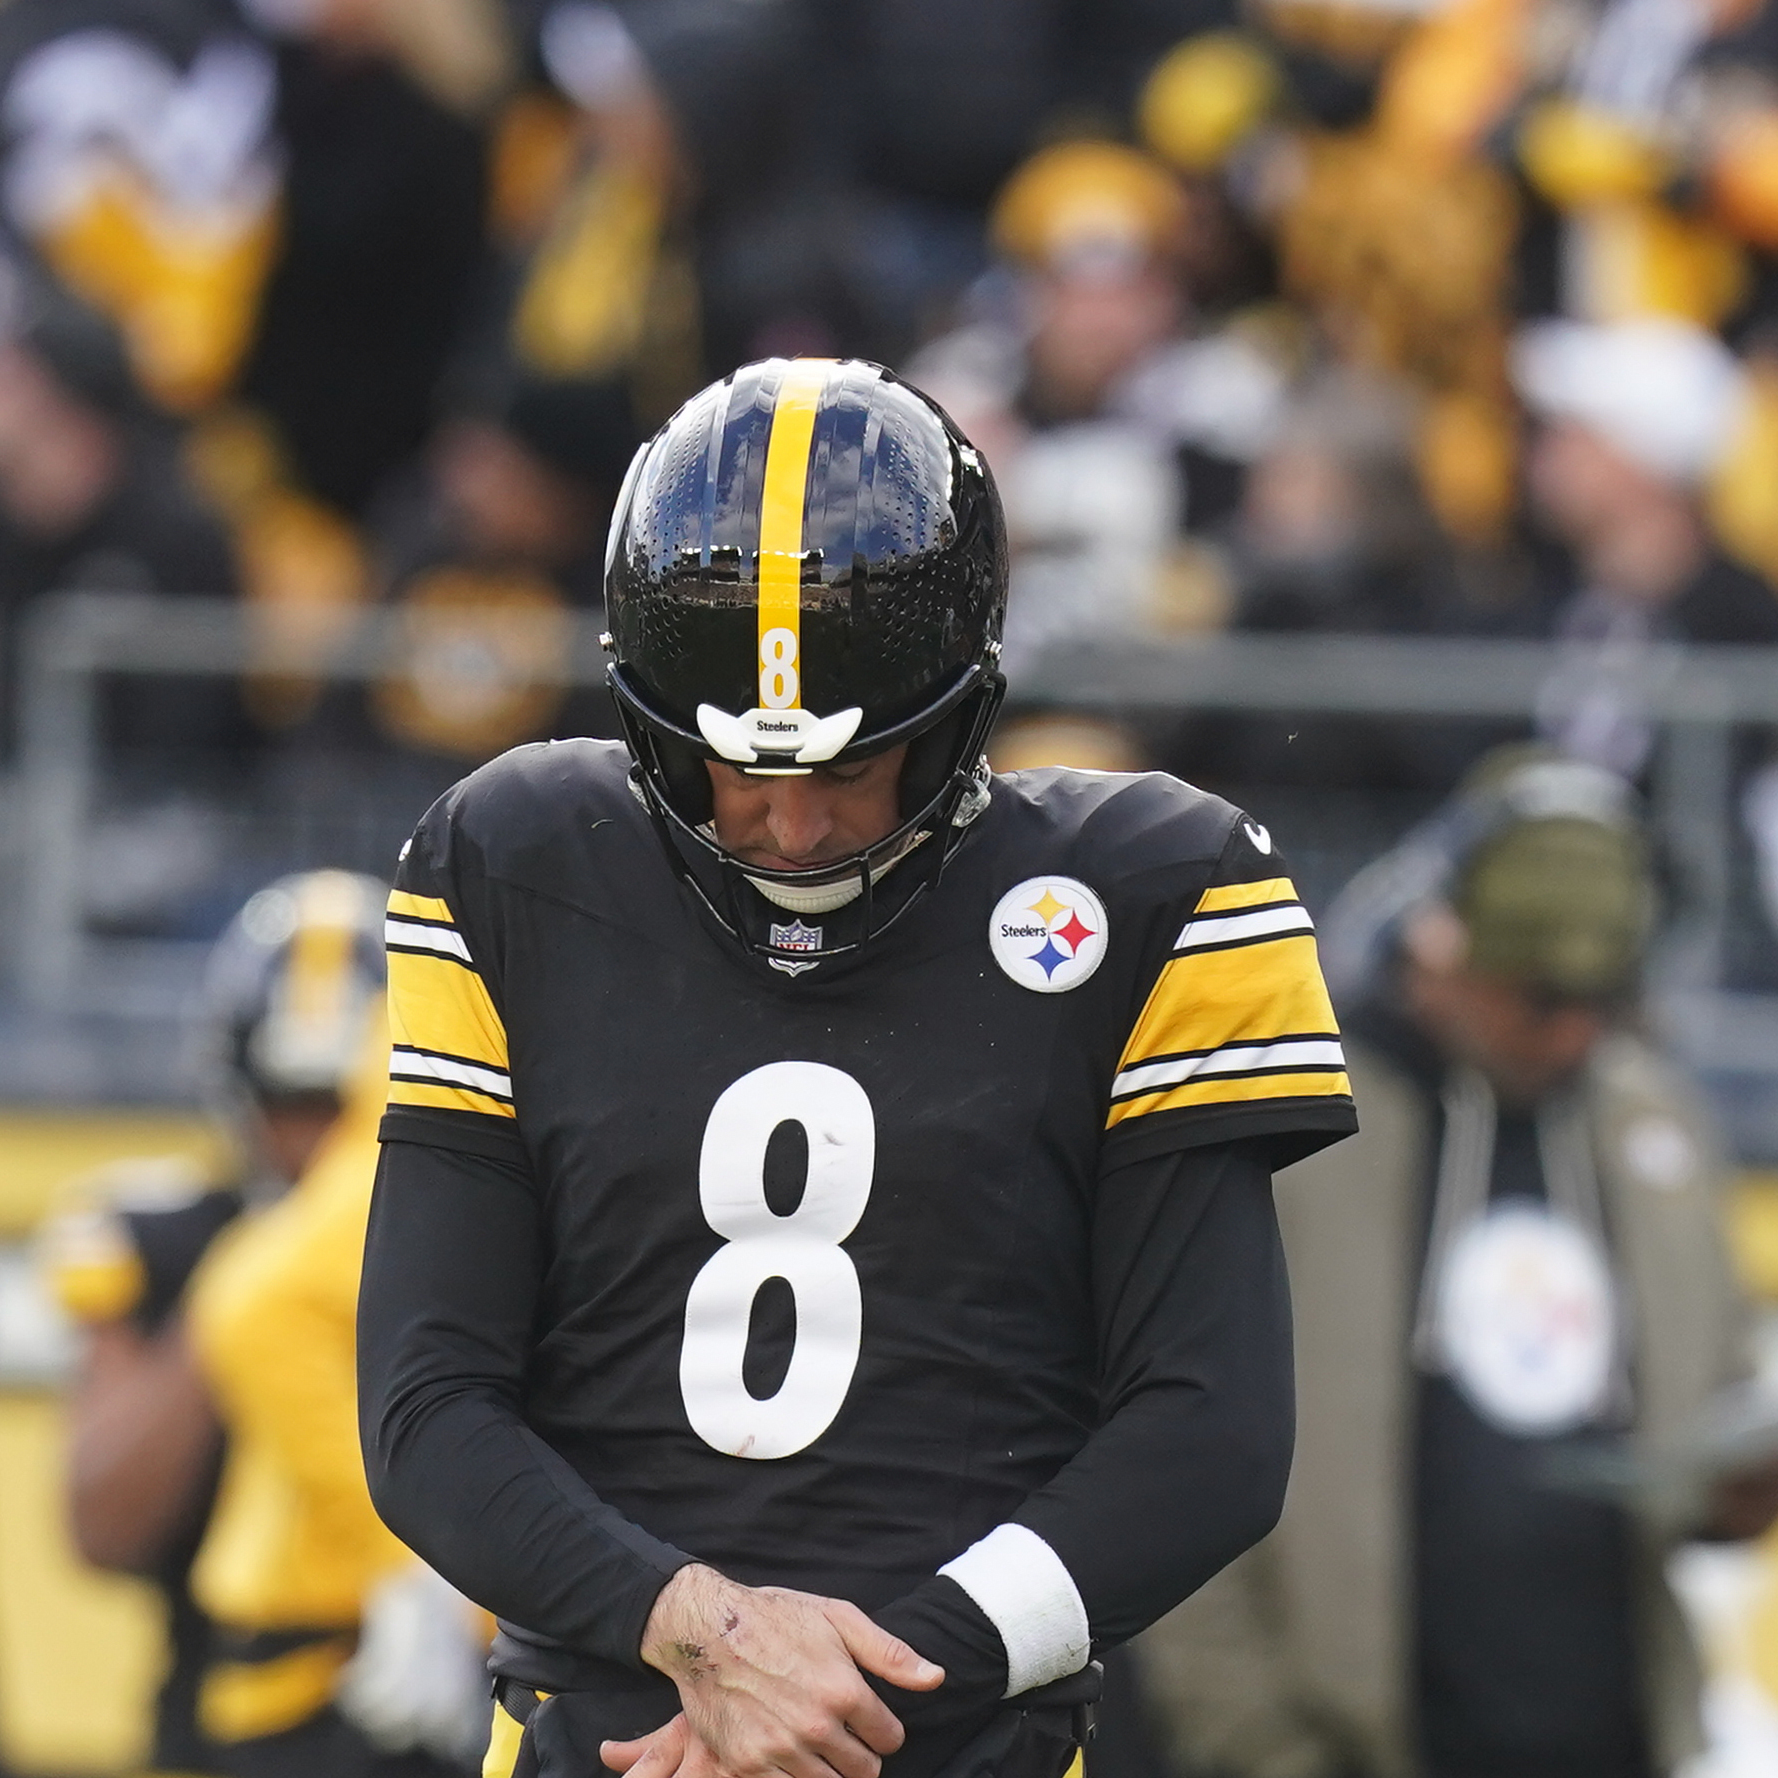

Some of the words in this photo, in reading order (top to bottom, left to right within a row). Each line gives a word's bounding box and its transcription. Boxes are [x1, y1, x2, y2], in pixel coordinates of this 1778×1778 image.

[759, 627, 799, 709] 8
[756, 719, 799, 733] Steelers
[1000, 923, 1048, 939] Steelers
[678, 1060, 877, 1460] 8
